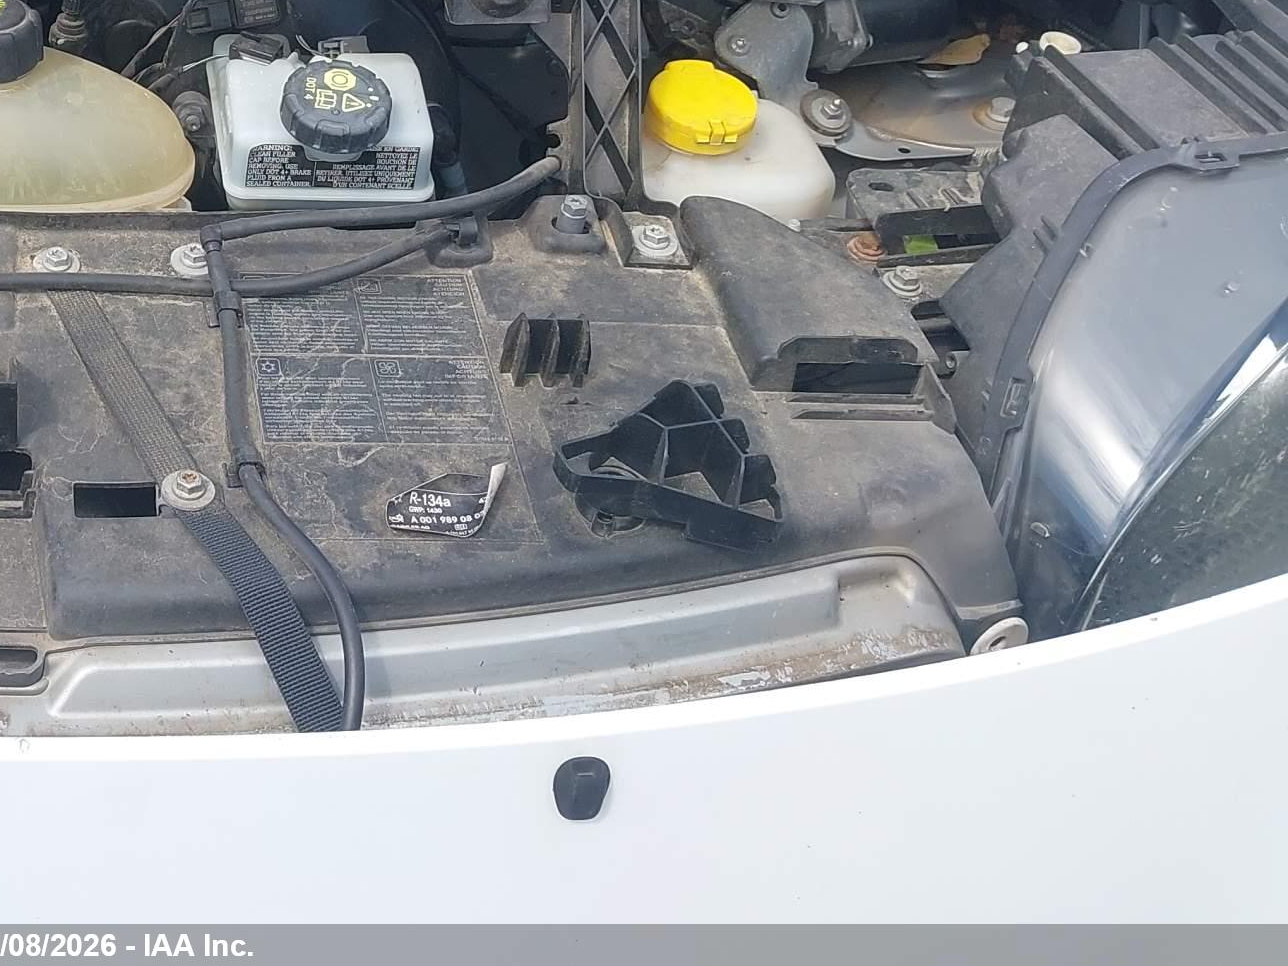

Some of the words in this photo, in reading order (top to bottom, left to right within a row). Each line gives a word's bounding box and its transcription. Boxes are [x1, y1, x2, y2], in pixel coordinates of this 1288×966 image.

[306, 76, 317, 93] DOT
[409, 491, 452, 507] R-134a
[411, 515, 418, 524] A
[419, 515, 437, 524] 001
[439, 515, 458, 524] 989
[459, 515, 473, 523] 08
